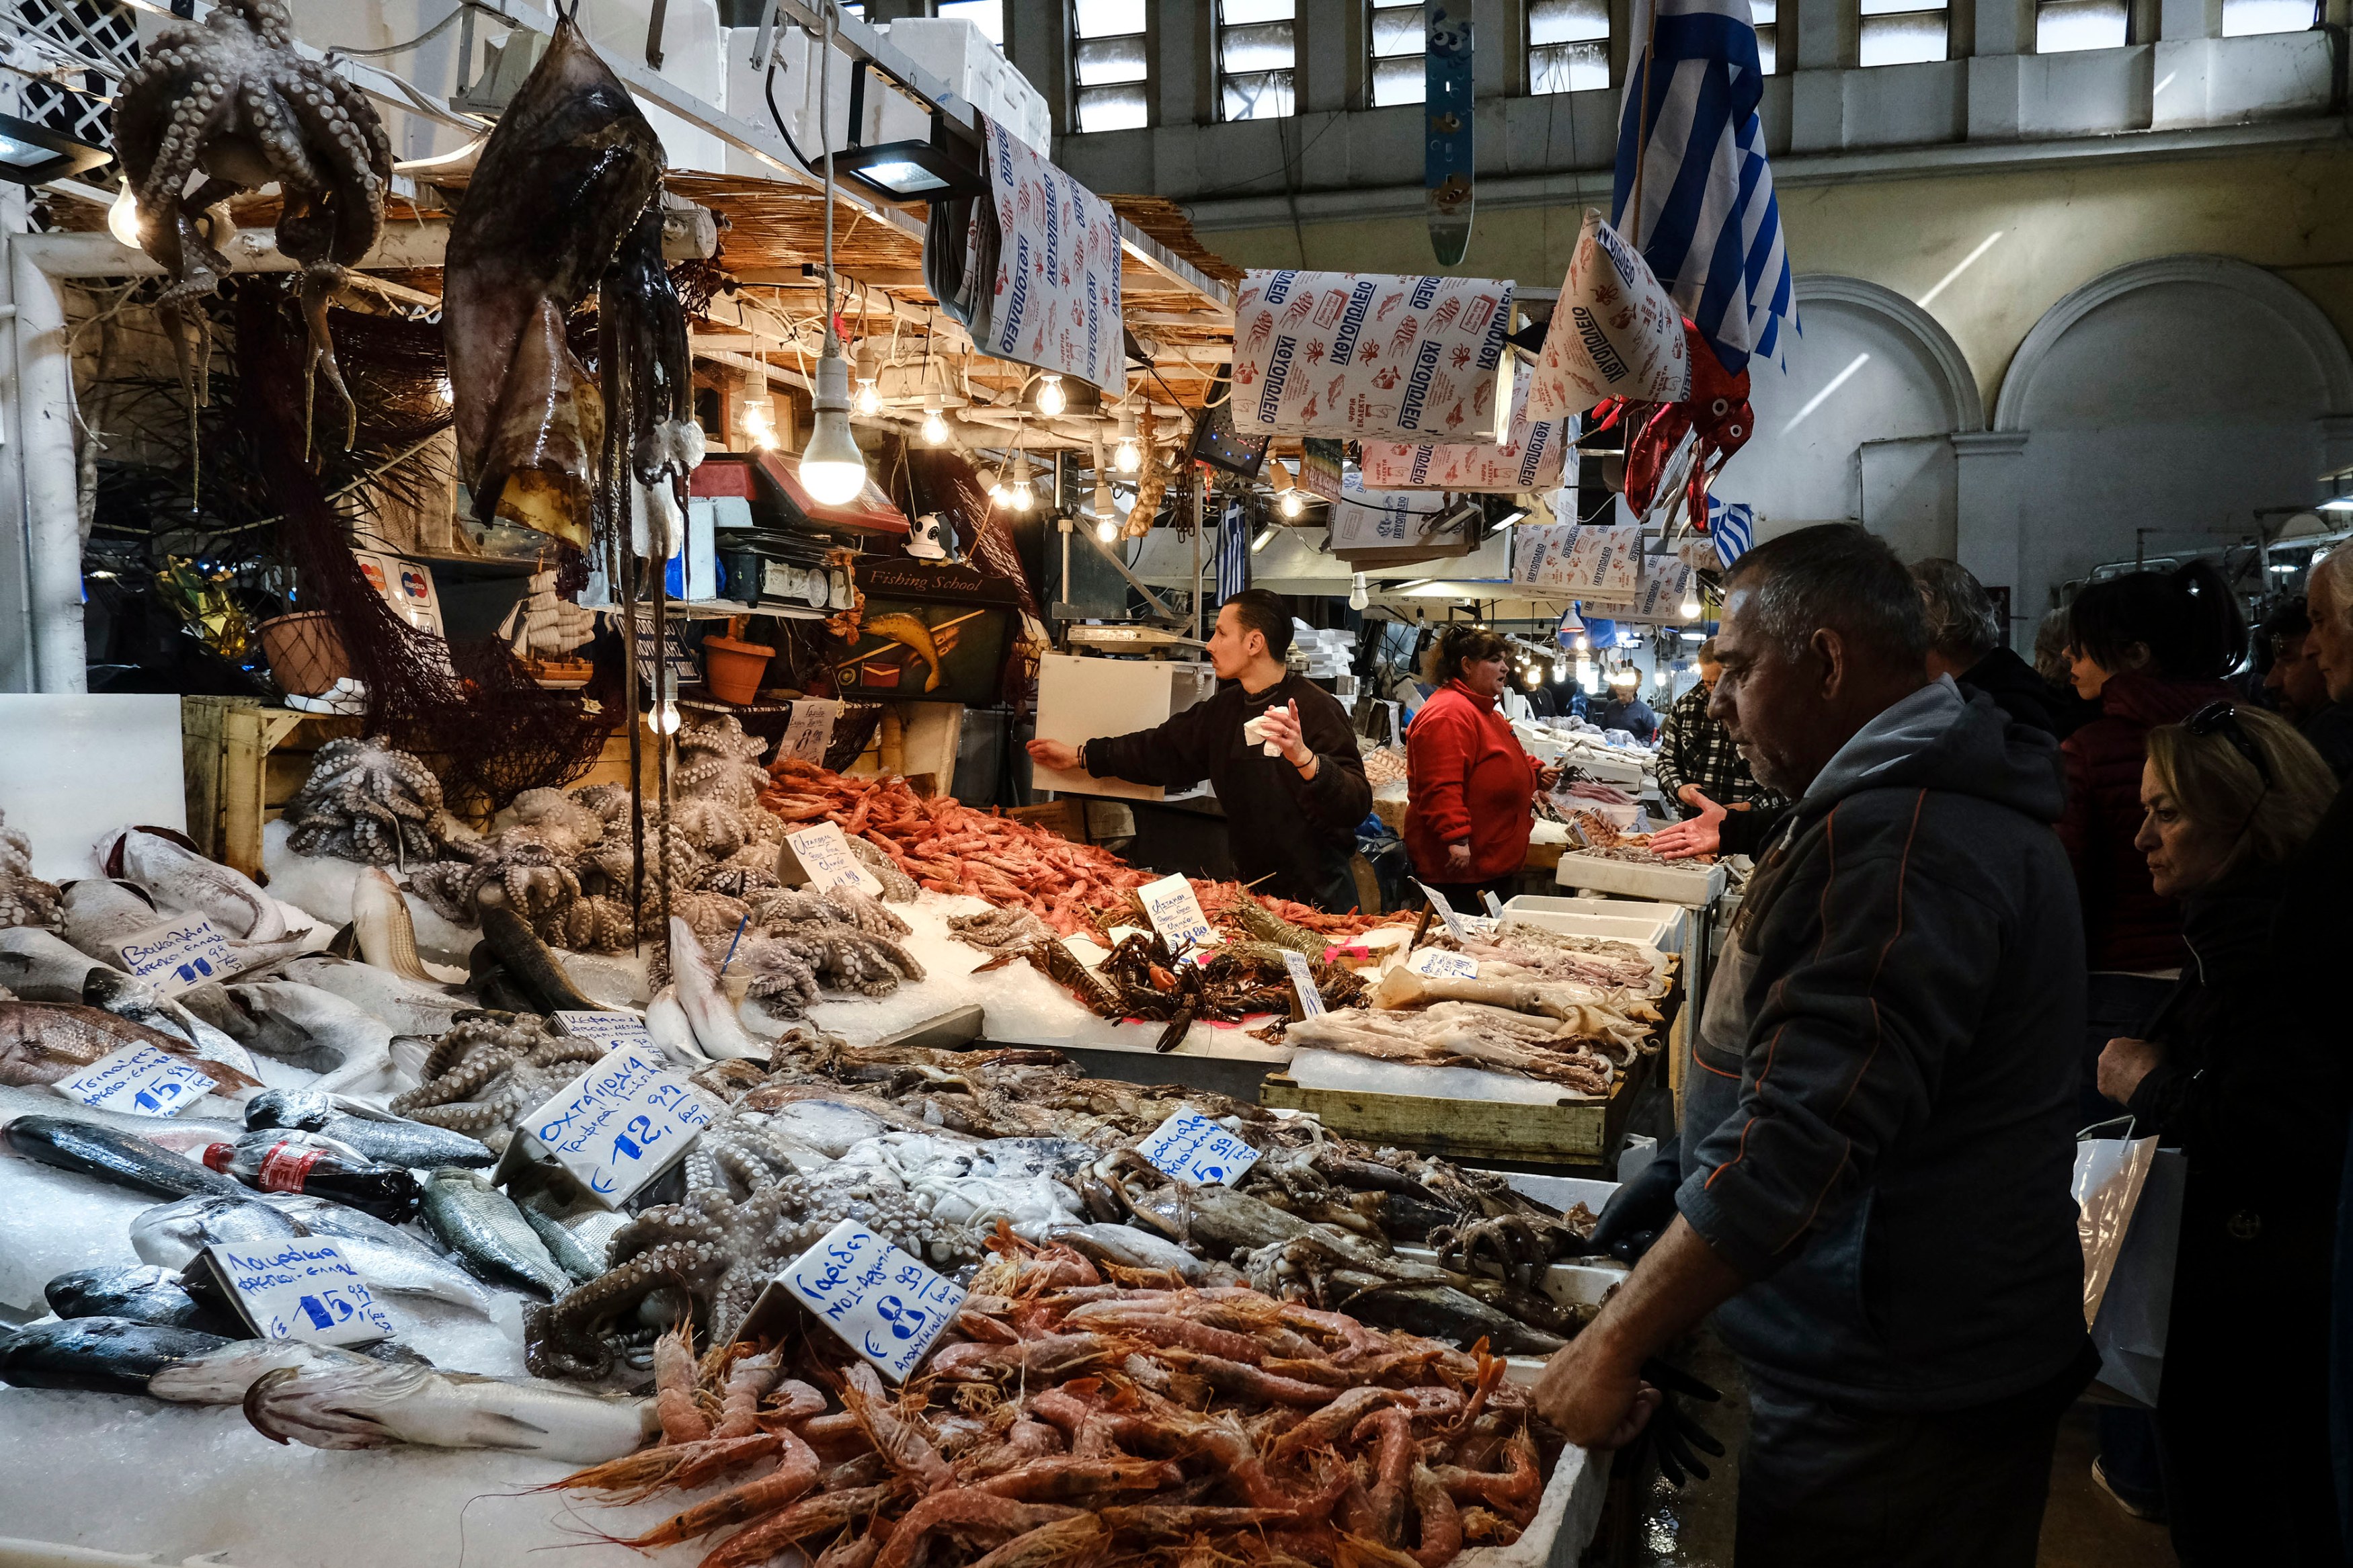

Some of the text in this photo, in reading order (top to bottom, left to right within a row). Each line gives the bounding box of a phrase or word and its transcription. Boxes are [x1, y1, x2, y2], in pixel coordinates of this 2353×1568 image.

[1002, 234, 1029, 354] ΙΧΘΥΟΠΩΛΕΙΟ
[1330, 281, 1373, 366] ΙΧΘΥΟΠΩΛΕΙΟ
[1572, 306, 1626, 384] ΙΧΘΥΟΠΩΛΕΙΟ
[1261, 336, 1297, 424] ΙΧΘΥΟΠΩΛΕΙΟ
[1402, 341, 1442, 430] ΙΧΘΥΟΠΩΛΕΙΟ
[1348, 398, 1356, 422] ΨΑΡΙΑ
[1357, 393, 1365, 427] ΕΚΛΕΚΤΑ
[1521, 421, 1551, 486] ΙΧΘΥΟΠΩΛΕΙΟ
[404, 580, 425, 590] Maestro
[870, 570, 983, 591] Fishing School
[1527, 543, 1544, 583] ΙΧΘΥΟΠΩΛΕΙΟ
[1593, 546, 1611, 586] ΙΧΘΥΟΠΩΛΕΙΟ
[1642, 579, 1659, 615] ΙΧΘΥΟΠΩΛΕΙΟ
[797, 1234, 871, 1301] Γαρίδες
